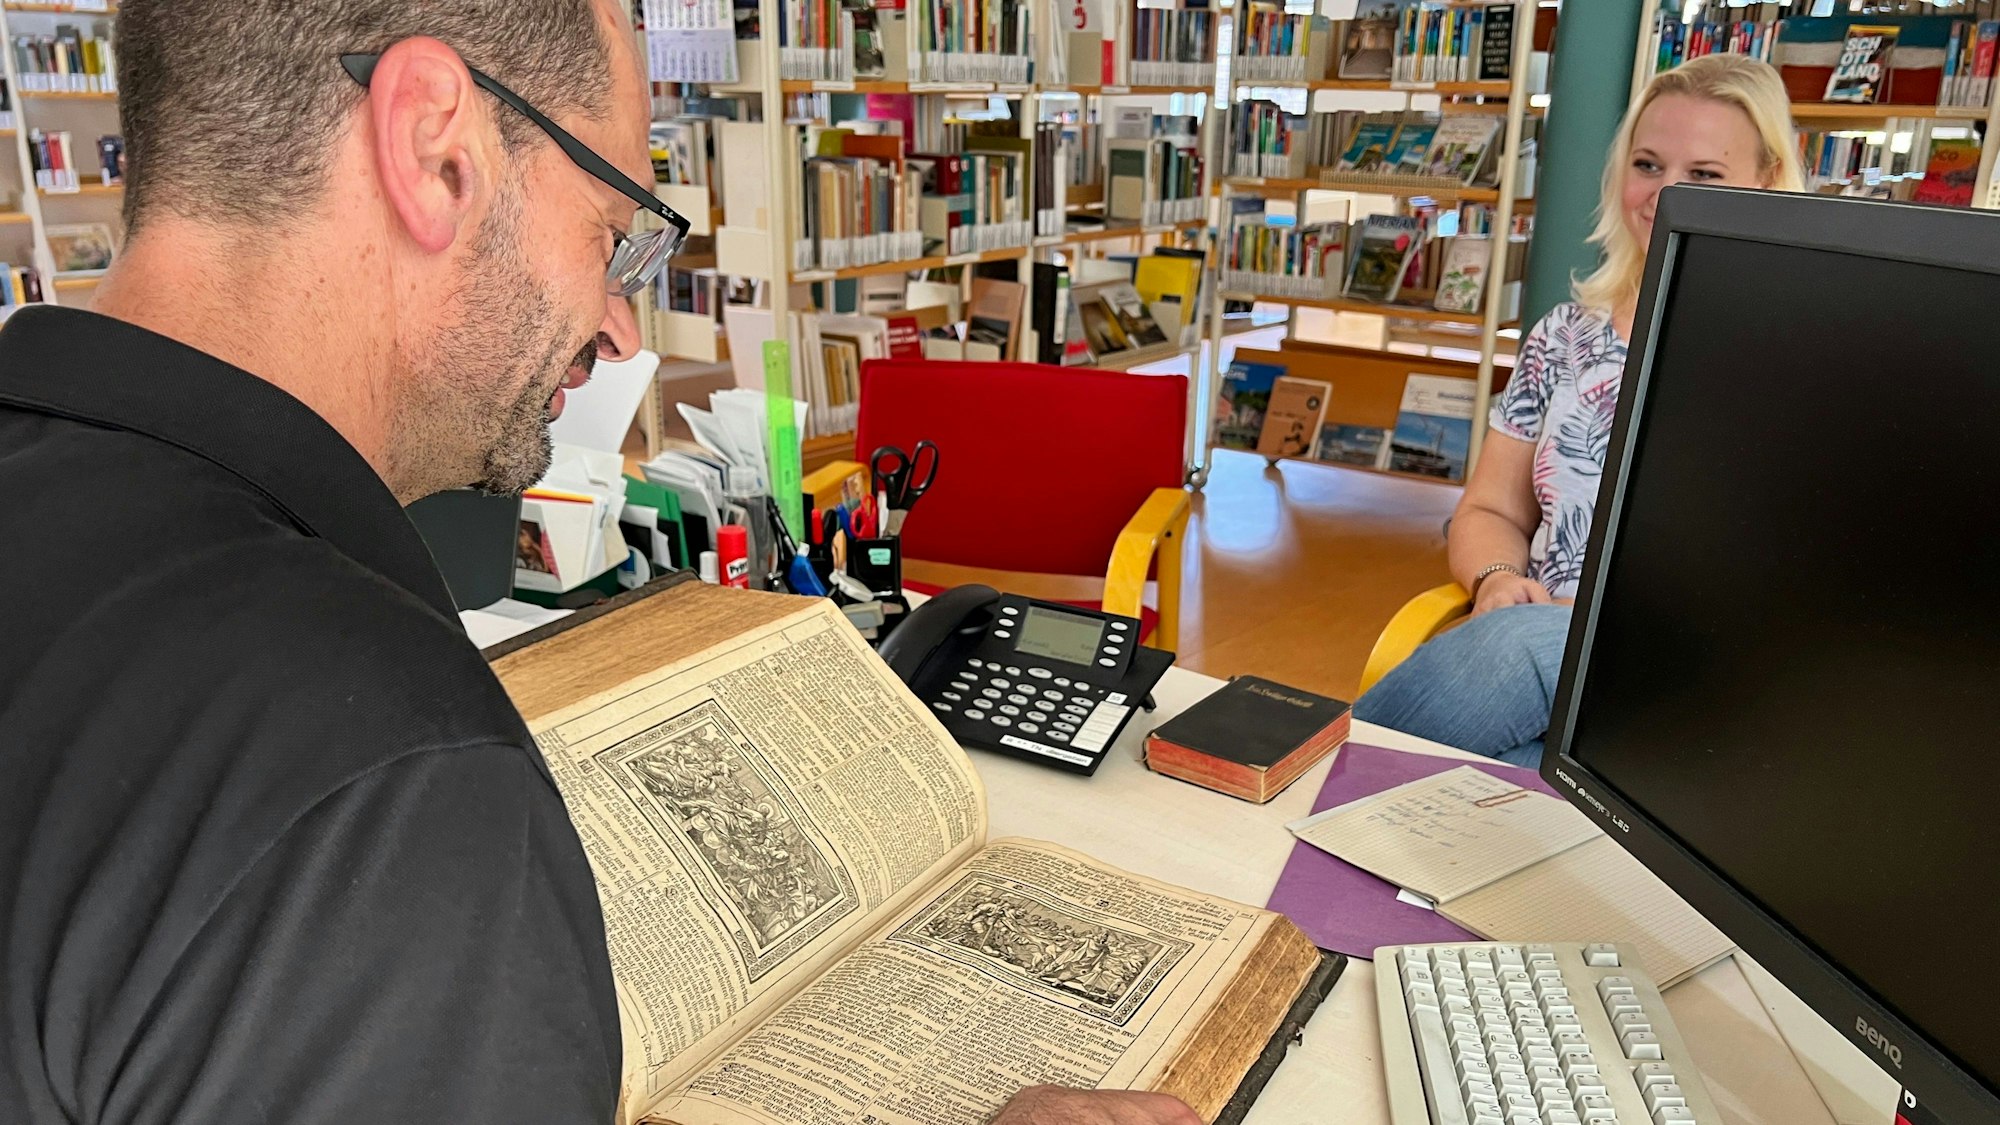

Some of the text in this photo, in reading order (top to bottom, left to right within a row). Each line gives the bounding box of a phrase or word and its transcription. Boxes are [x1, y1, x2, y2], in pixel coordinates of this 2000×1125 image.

[1846, 36, 1882, 51] SCH
[1840, 51, 1874, 64] OTT
[1836, 62, 1880, 80] LAND
[1556, 768, 1576, 790] HDMI
[1856, 1016, 1902, 1070] BenQ
